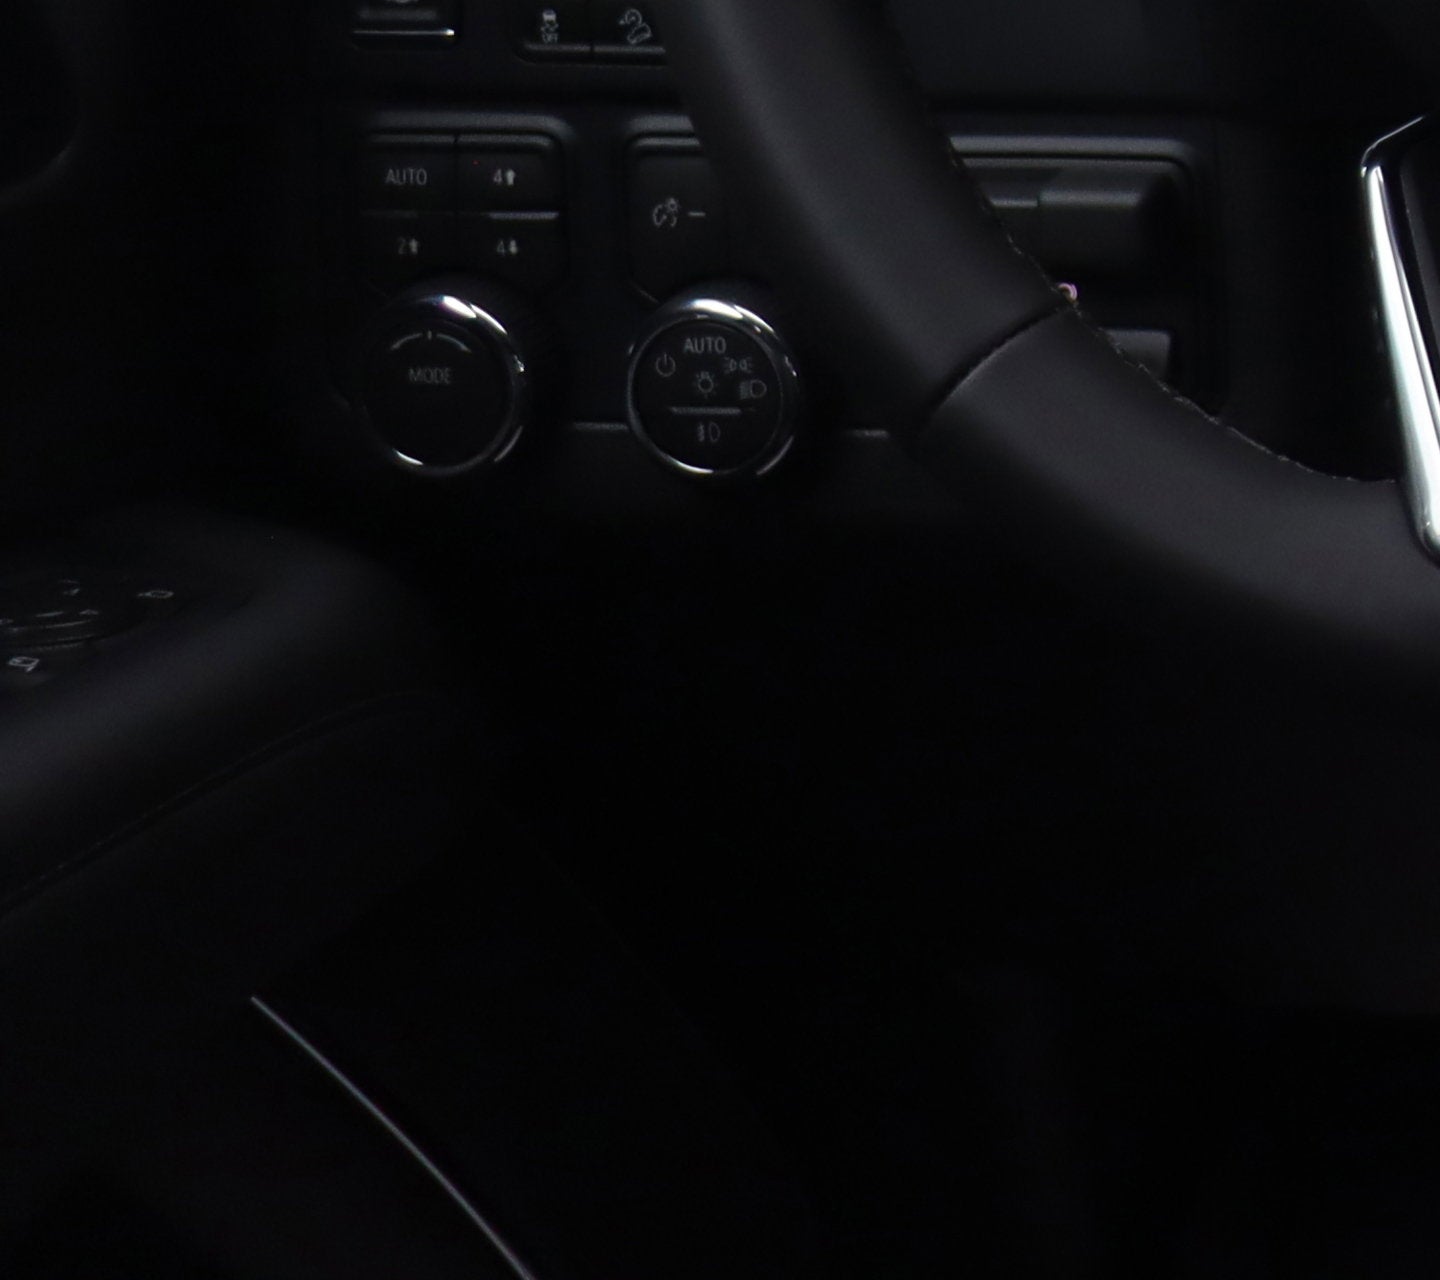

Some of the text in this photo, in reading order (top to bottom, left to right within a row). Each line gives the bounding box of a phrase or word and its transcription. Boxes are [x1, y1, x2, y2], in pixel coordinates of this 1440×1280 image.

[385, 168, 428, 186] AUTO
[683, 336, 726, 354] AUTO
[409, 368, 451, 384] MODE
